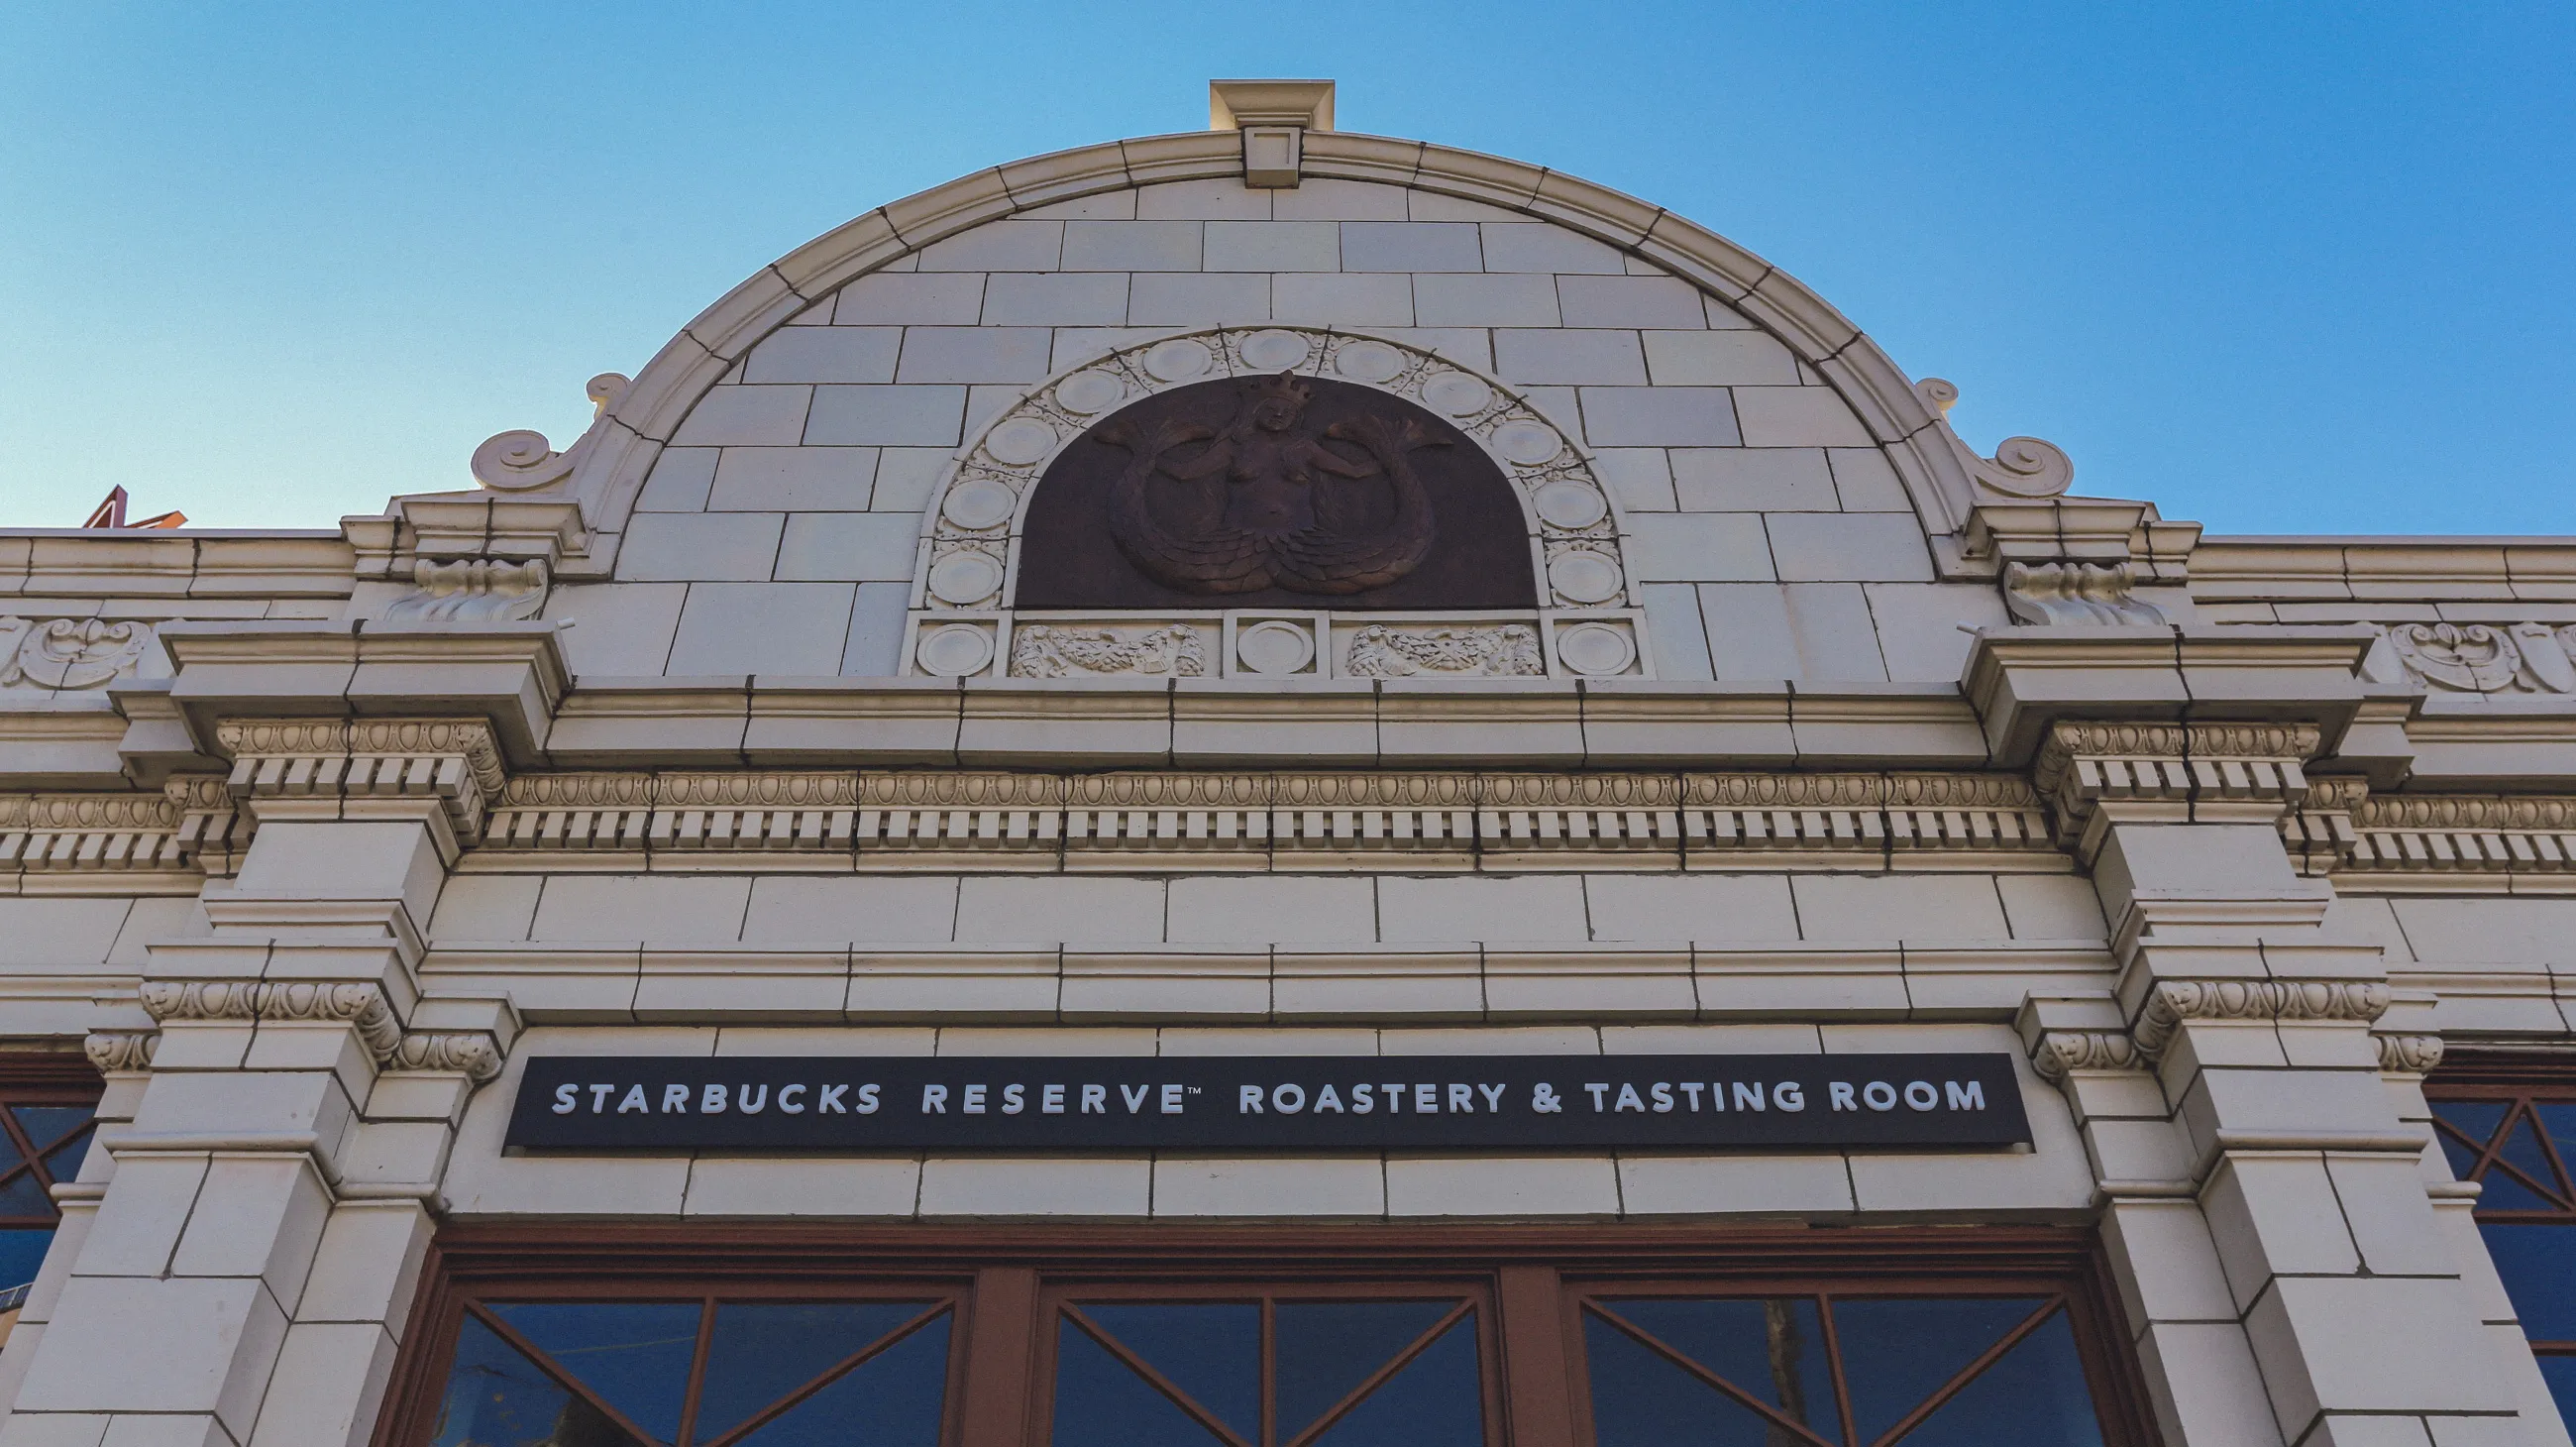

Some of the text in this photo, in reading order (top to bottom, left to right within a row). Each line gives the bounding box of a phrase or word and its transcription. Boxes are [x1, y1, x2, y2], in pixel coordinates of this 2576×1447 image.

[551, 1082, 882, 1114] STARBUCKS
[1238, 1082, 1507, 1114] ROASTERY
[1531, 1081, 1562, 1113] &
[1582, 1081, 1806, 1114] TASTING
[1828, 1079, 1987, 1112] ROOM
